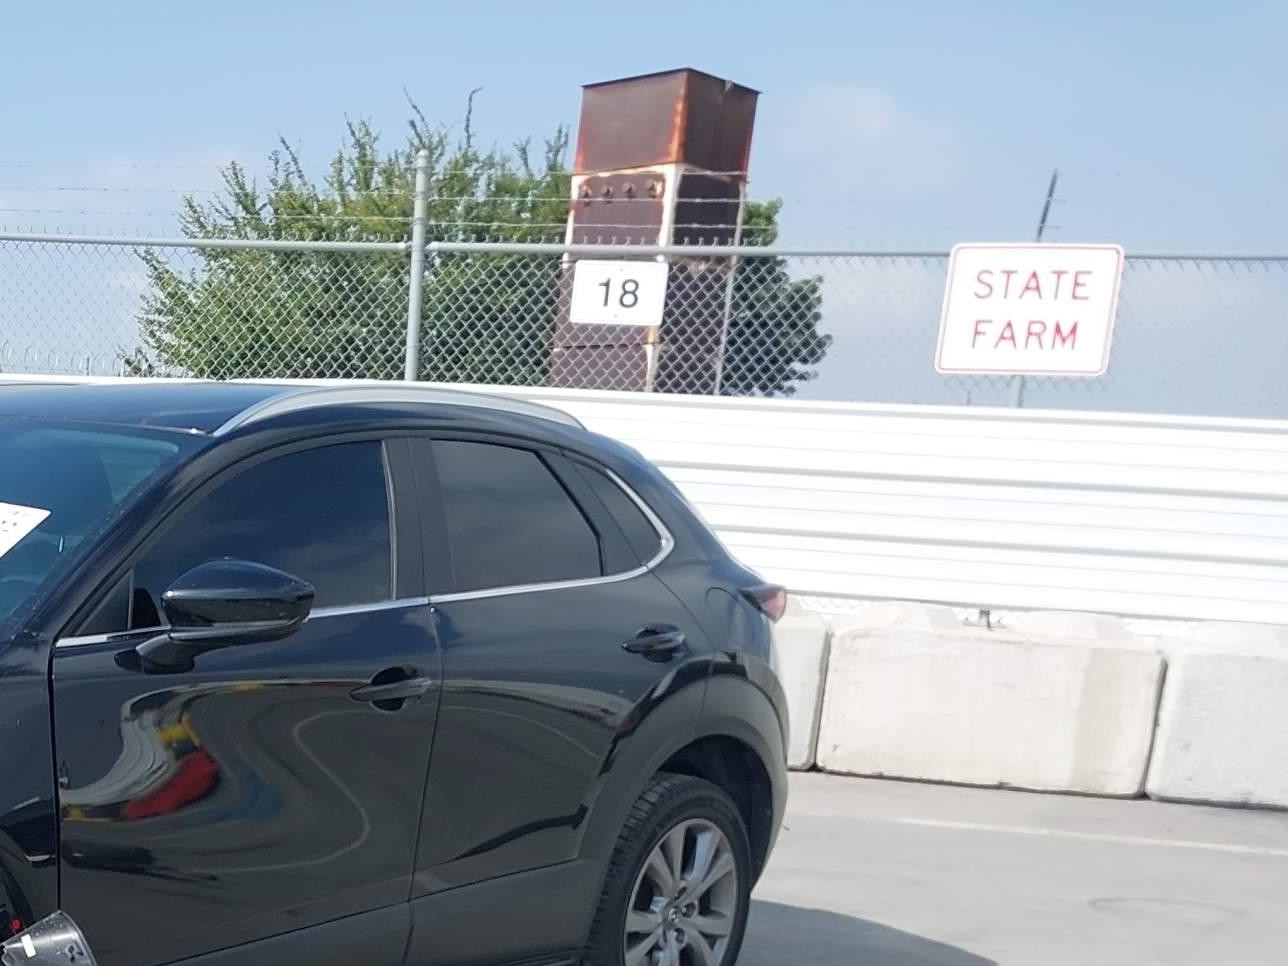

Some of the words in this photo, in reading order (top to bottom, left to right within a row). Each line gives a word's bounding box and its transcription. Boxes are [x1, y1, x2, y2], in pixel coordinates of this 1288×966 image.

[598, 277, 640, 309] 18
[973, 269, 1093, 301] STATE
[971, 319, 1079, 351] FARM
